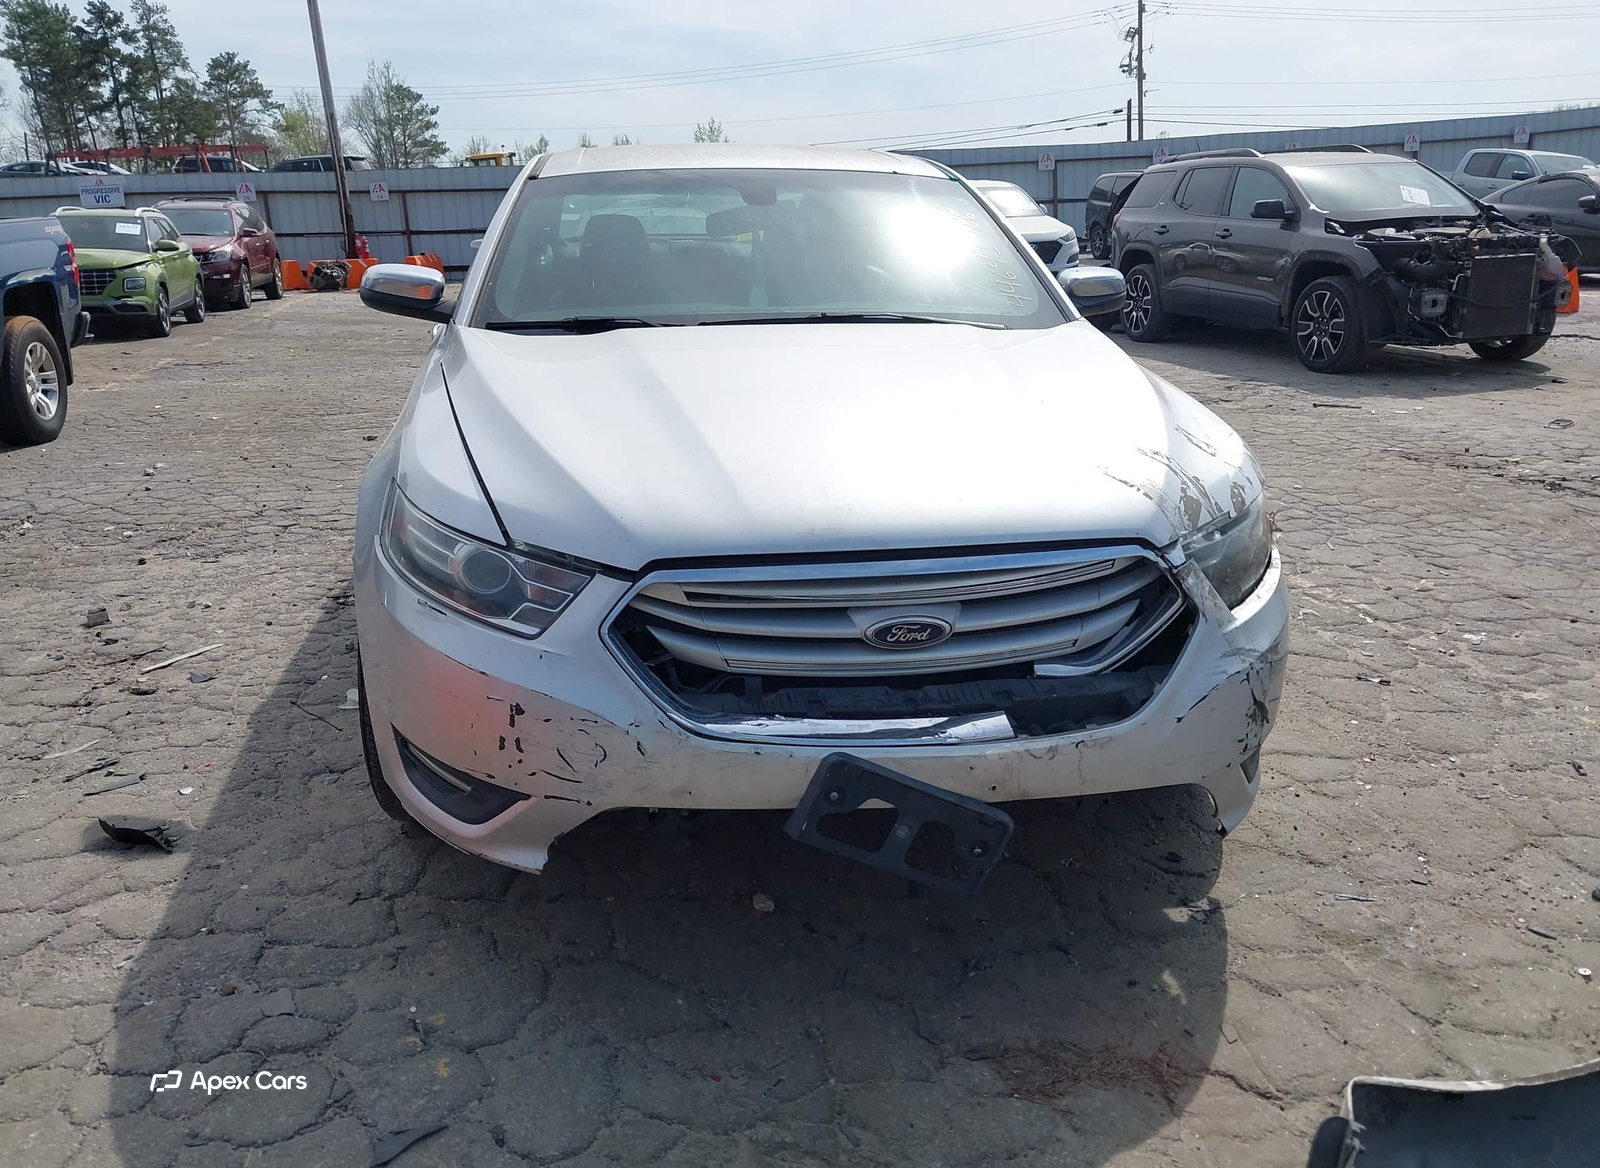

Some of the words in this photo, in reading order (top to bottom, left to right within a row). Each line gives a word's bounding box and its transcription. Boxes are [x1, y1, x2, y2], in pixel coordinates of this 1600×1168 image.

[80, 186, 121, 195] PROGRESSIVE
[94, 194, 111, 204] VIC
[886, 624, 932, 642] Ford
